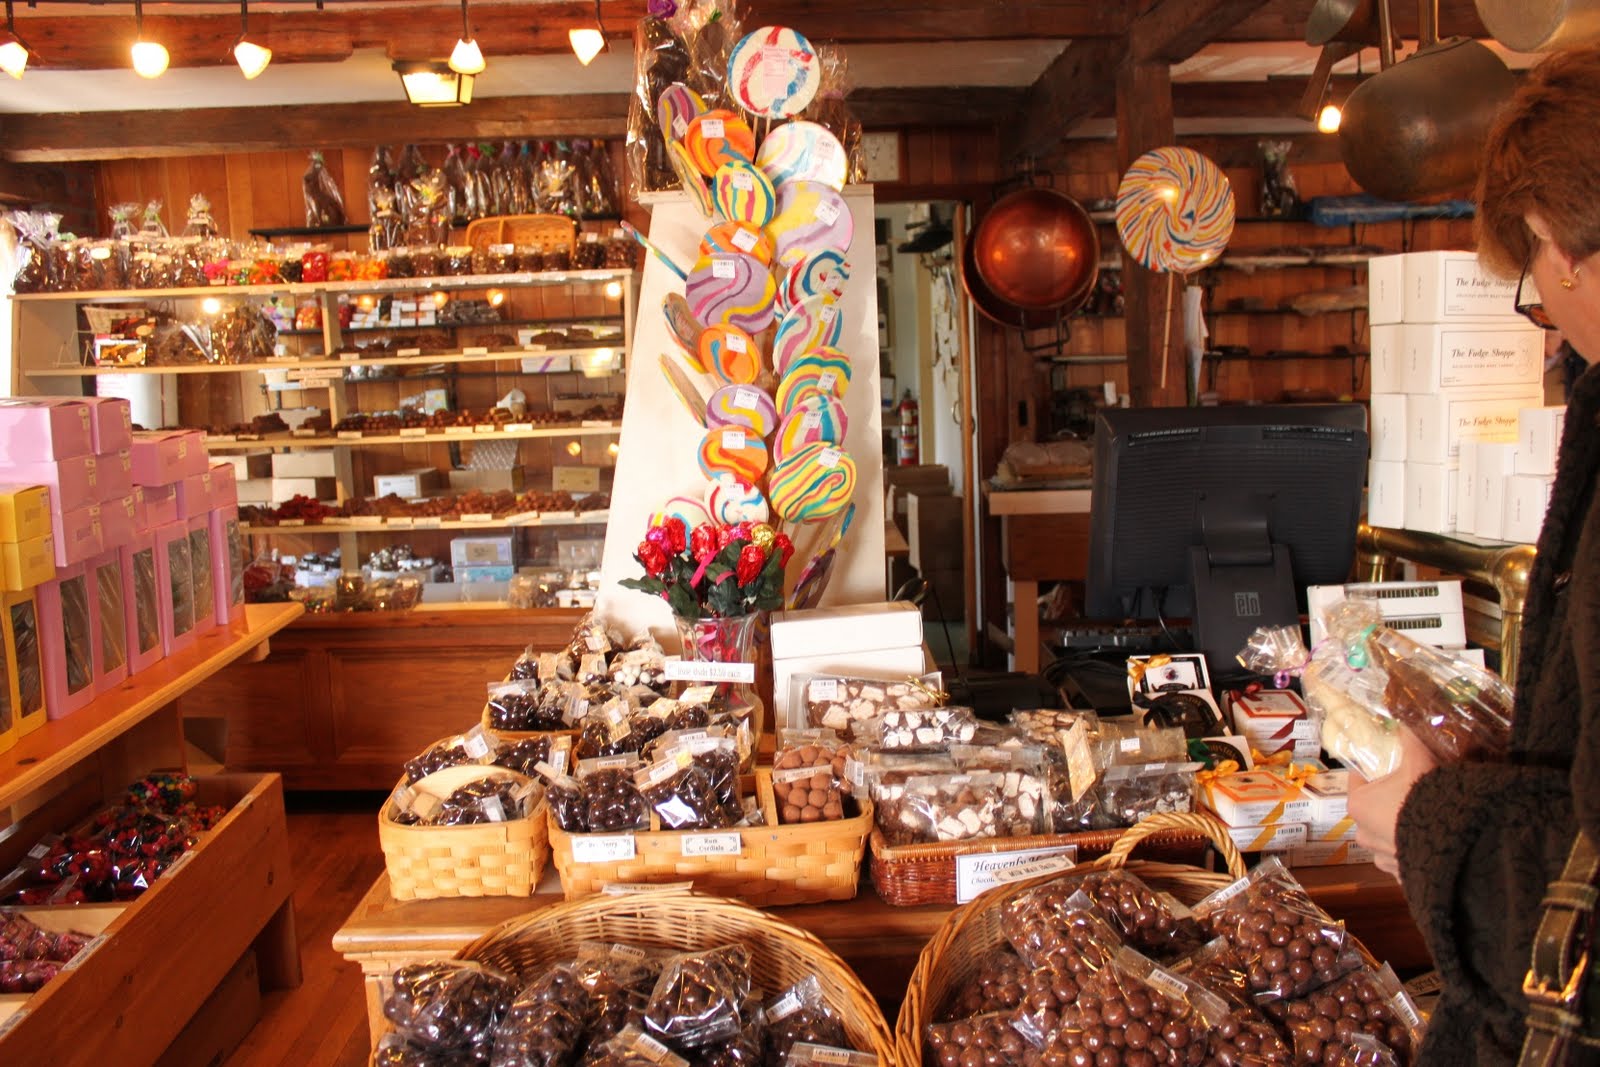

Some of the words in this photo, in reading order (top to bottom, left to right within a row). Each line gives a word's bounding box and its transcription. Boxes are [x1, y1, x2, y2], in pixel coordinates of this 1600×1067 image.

[1456, 277, 1469, 287] The
[1471, 277, 1491, 289] Fudge
[1451, 348, 1465, 358] The
[1468, 348, 1489, 359] Fudge
[1492, 348, 1515, 359] Shoppe
[1459, 417, 1471, 427] The
[1473, 416, 1492, 428] Fudge
[1495, 416, 1517, 428] Shoppe
